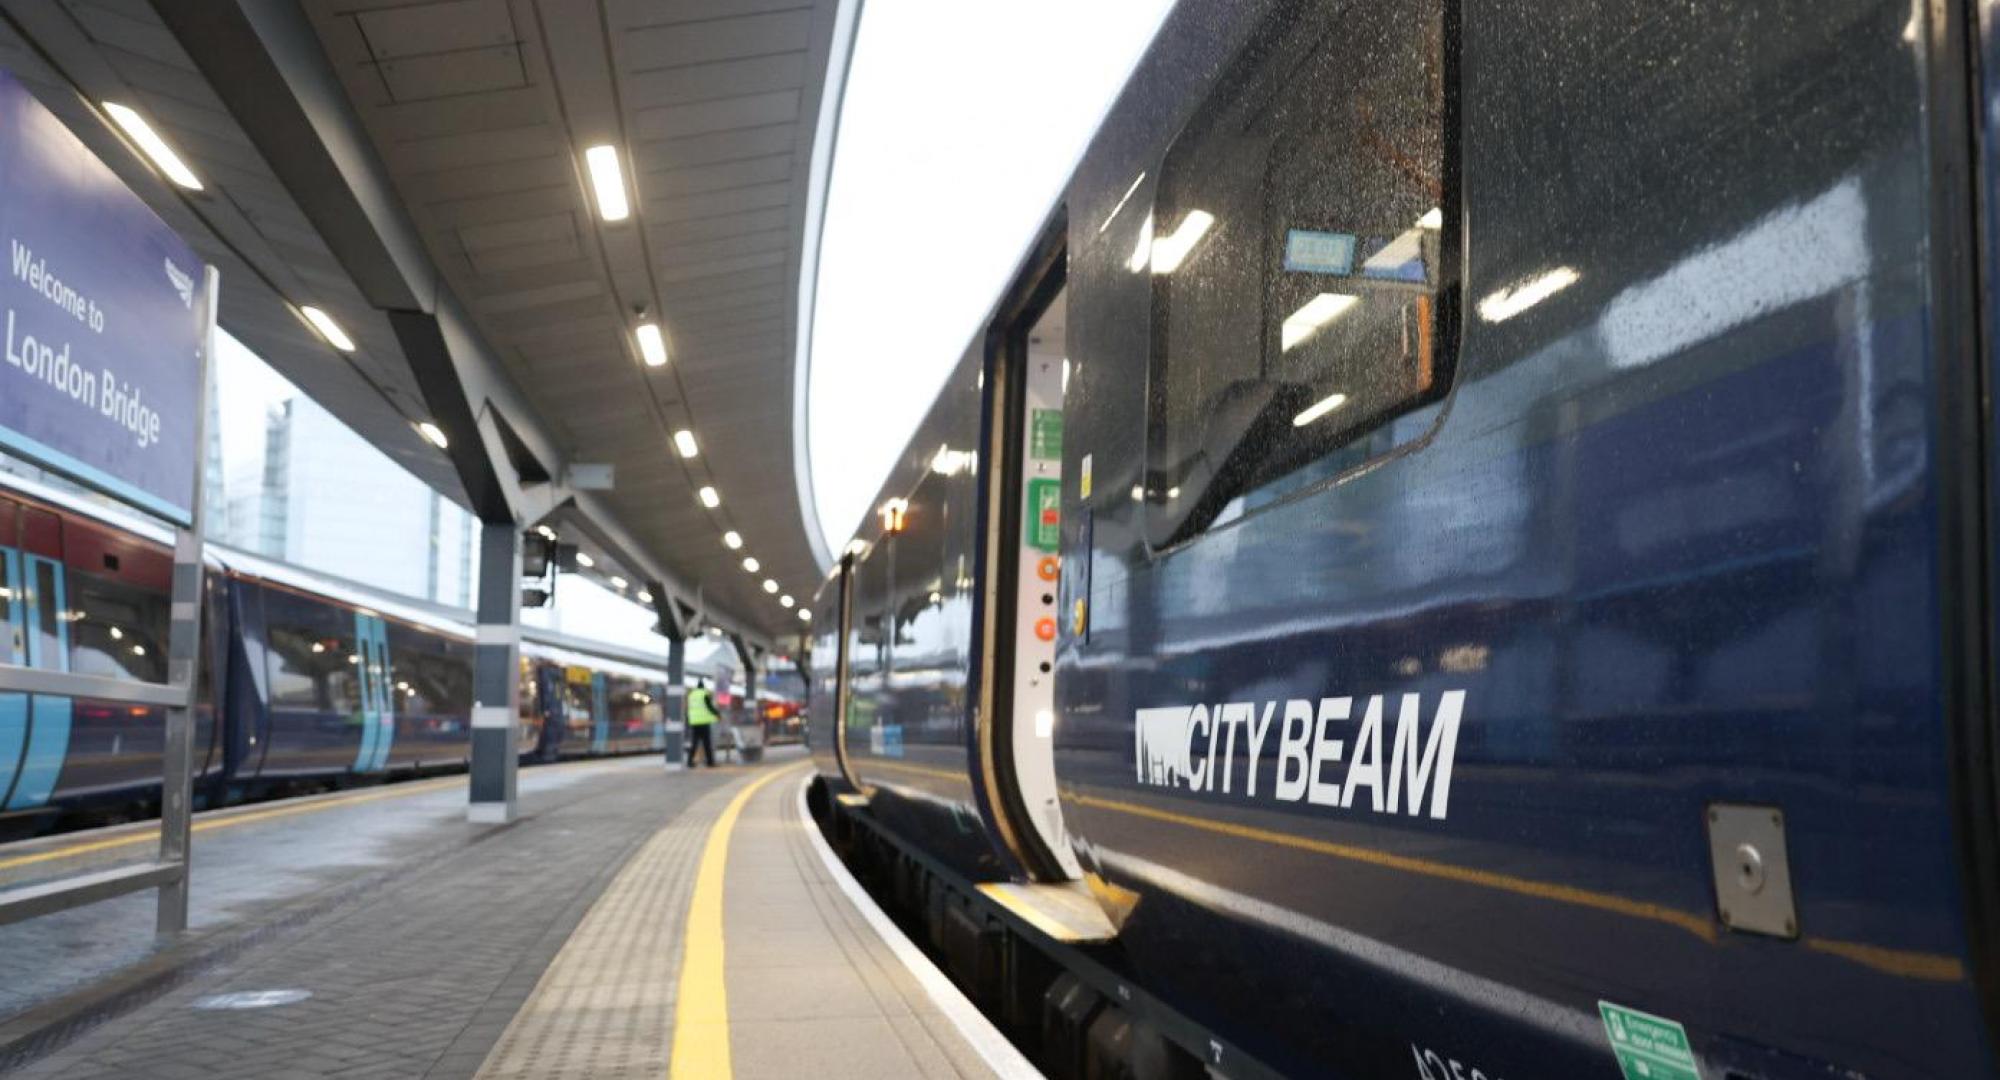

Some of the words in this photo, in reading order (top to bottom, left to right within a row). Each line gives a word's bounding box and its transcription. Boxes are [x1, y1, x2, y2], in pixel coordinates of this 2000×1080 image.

[12, 239, 86, 321] Welcome
[88, 300, 104, 333] to
[6, 309, 96, 408] London
[101, 368, 160, 448] Bridge
[1185, 701, 1277, 797] CITY
[1275, 689, 1466, 820] BEAM
